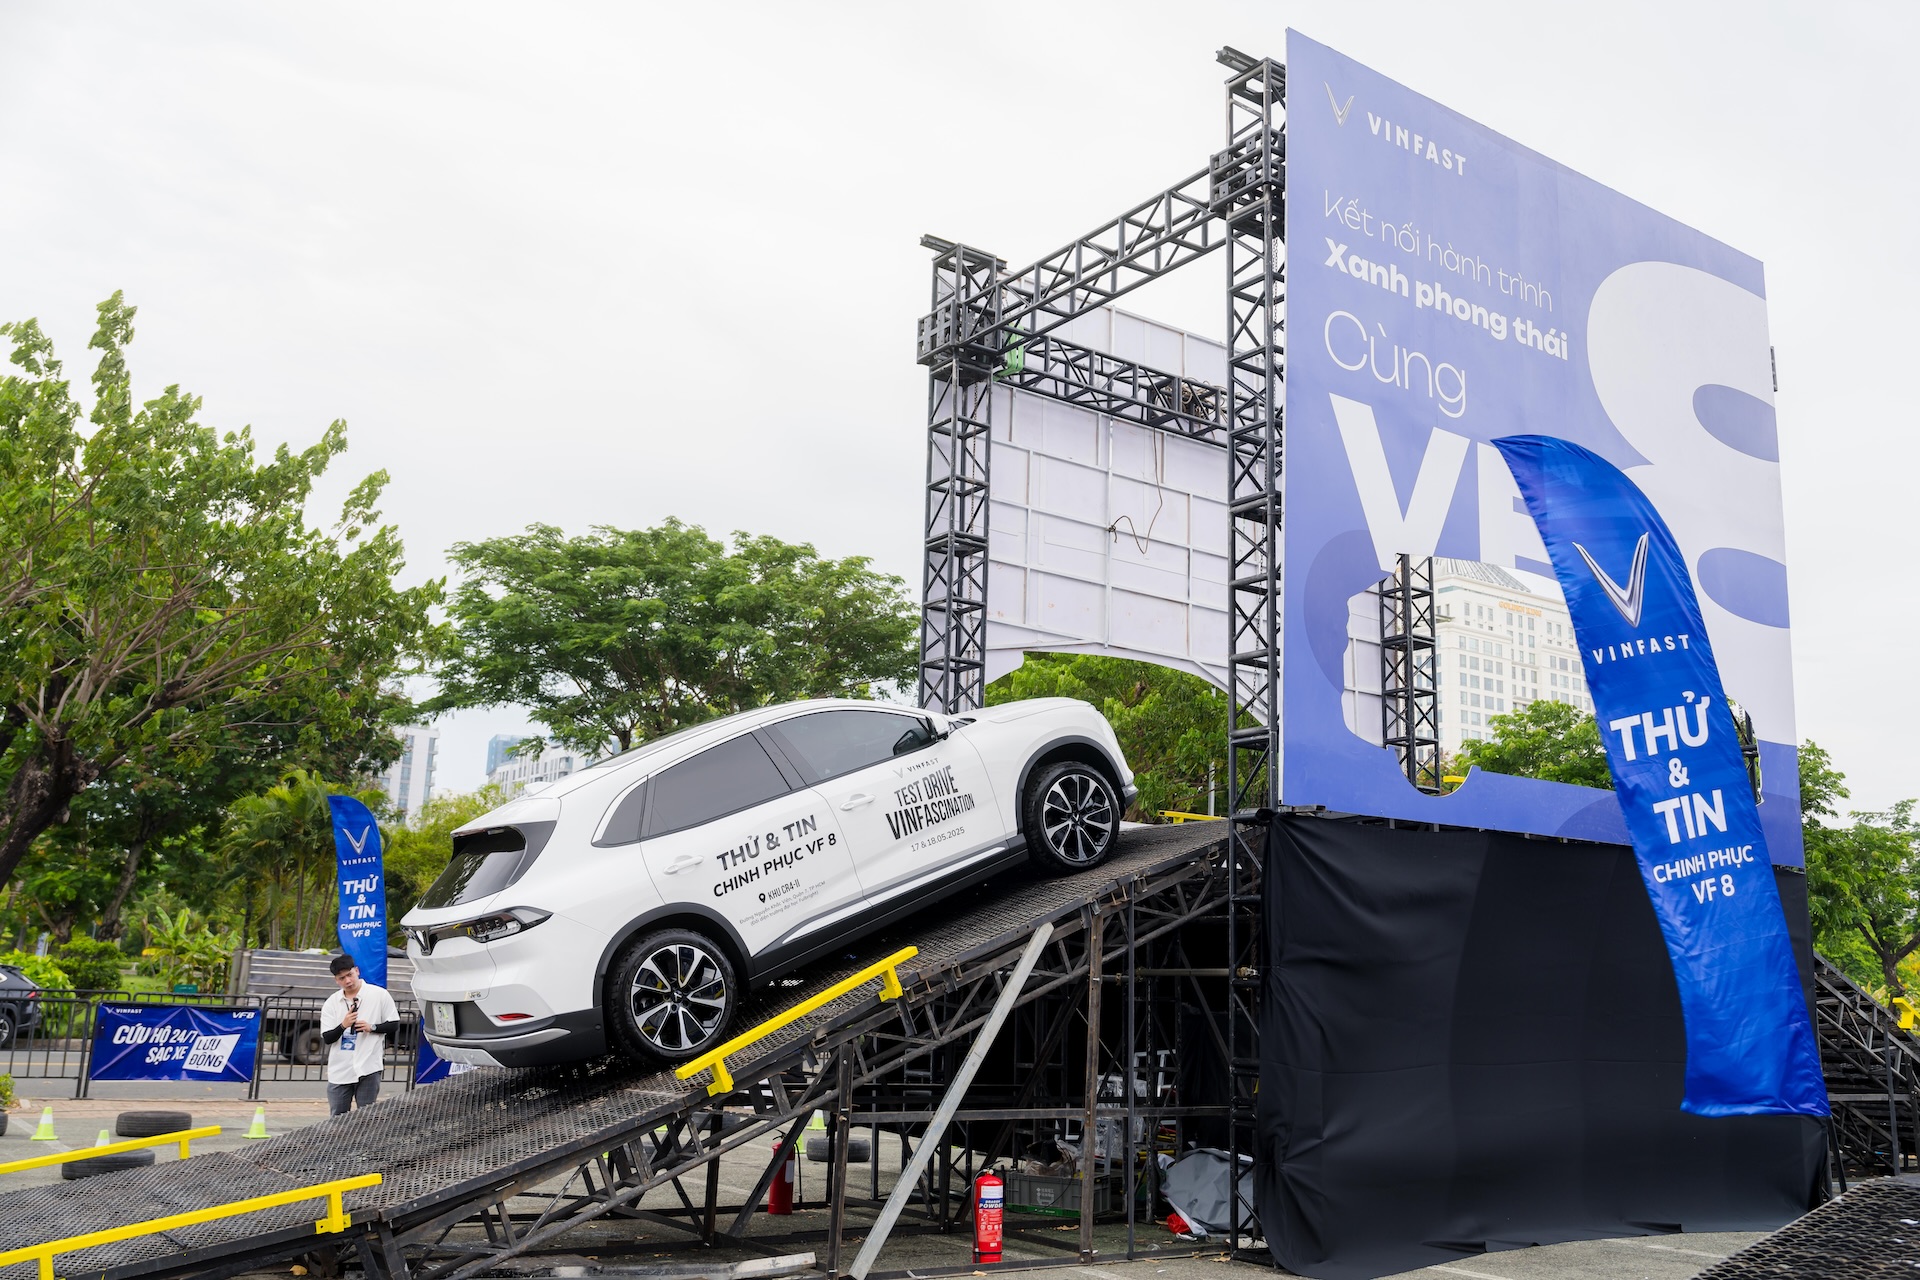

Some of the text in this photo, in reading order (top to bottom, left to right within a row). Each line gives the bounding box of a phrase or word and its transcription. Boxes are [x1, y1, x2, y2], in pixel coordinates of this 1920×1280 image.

[1367, 112, 1466, 176] VINFAST
[1325, 189, 1553, 313] Kết nối hành trình
[1325, 237, 1568, 361] Xanh phong thái
[1324, 310, 1466, 418] Cùng
[1593, 634, 1689, 664] VINFAST
[1609, 690, 1711, 762] THỬ
[907, 758, 939, 772] VINFAST
[1668, 757, 1690, 788] &
[894, 764, 959, 807] TEST DRIVE
[885, 793, 976, 841] VINFASCINATION
[1653, 789, 1728, 845] TIN
[716, 814, 817, 872] THỬ & TIN
[911, 826, 966, 852] 17 & 18.05.2025
[342, 856, 377, 866] VINFAST
[713, 833, 837, 897] CHINH PHỤC VF 8
[1653, 845, 1754, 884] CHINH PHỤC
[342, 873, 379, 895] THỬ
[768, 888, 781, 901] KHU
[1691, 874, 1736, 904] VF 8
[348, 904, 376, 920] TIN
[357, 894, 366, 904] &
[352, 929, 371, 938] VF 8
[363, 921, 382, 930] PHỤC
[232, 1011, 255, 1019] VF8
[112, 1023, 198, 1047] CỨU HỘ 24/7
[196, 1038, 222, 1051] LƯU
[145, 1046, 189, 1066] SẠC XE
[188, 1051, 224, 1069] ĐỘNG
